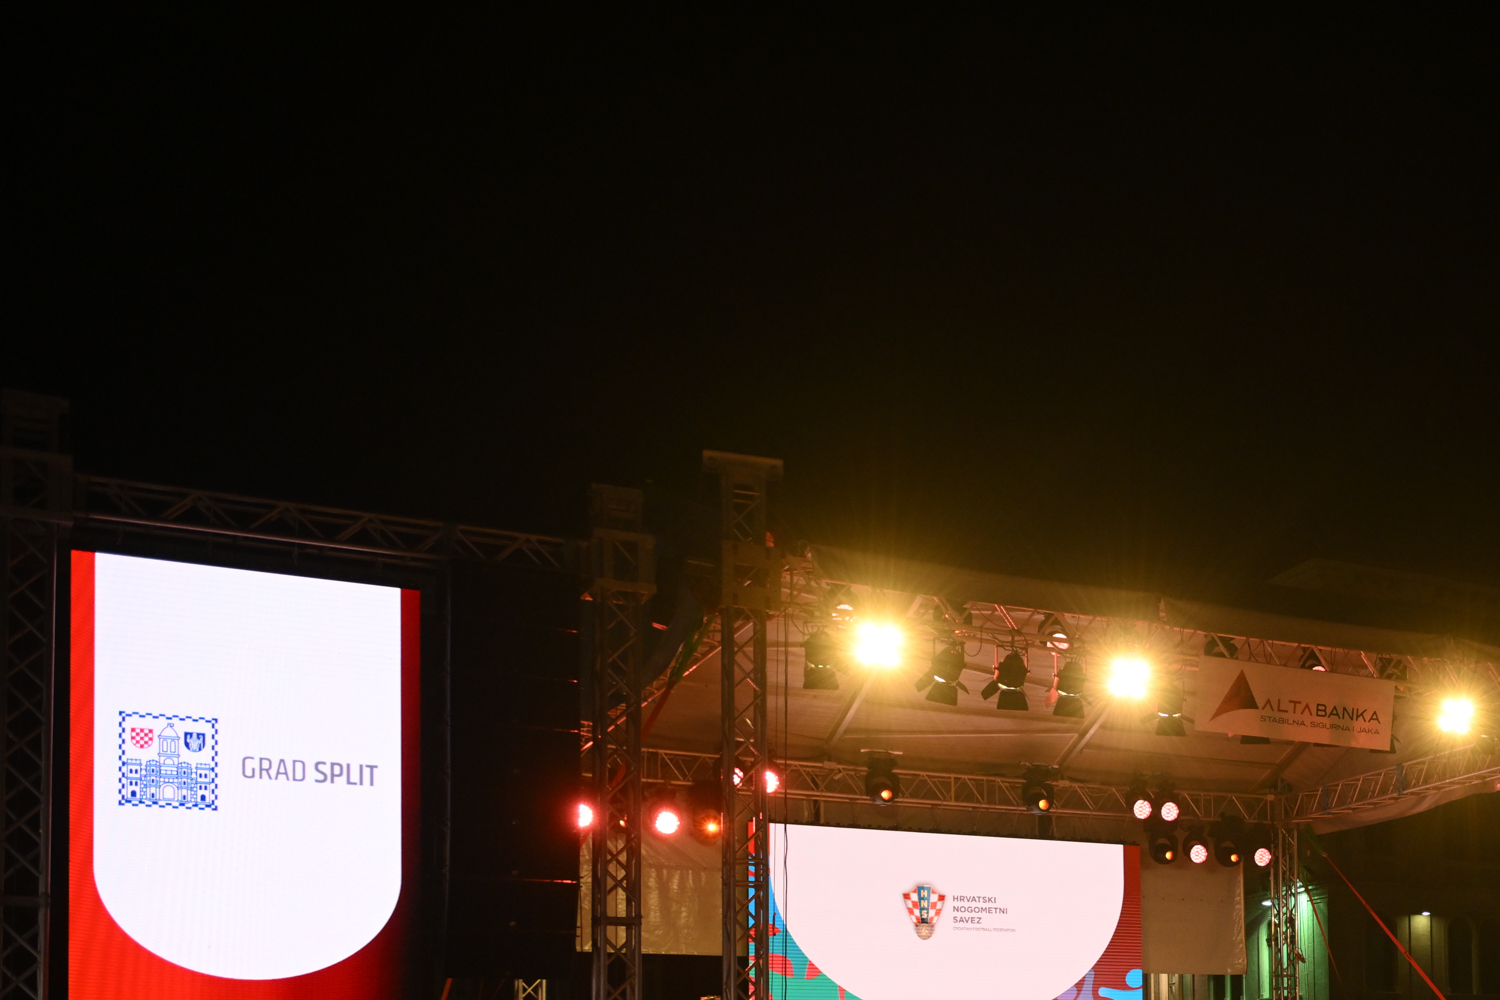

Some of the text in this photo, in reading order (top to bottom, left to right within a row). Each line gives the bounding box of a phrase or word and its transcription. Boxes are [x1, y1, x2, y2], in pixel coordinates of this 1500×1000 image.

[1261, 697, 1382, 725] ALTABANKA
[1260, 715, 1309, 728] STABILNA,
[1309, 721, 1351, 733] SIGURNA
[1356, 726, 1381, 735] JAKA
[241, 755, 379, 787] GRAD SPLIT
[952, 894, 998, 904] HRVATSKI
[952, 905, 1009, 915] NOGOMETNI
[952, 915, 983, 925] SAVEZ
